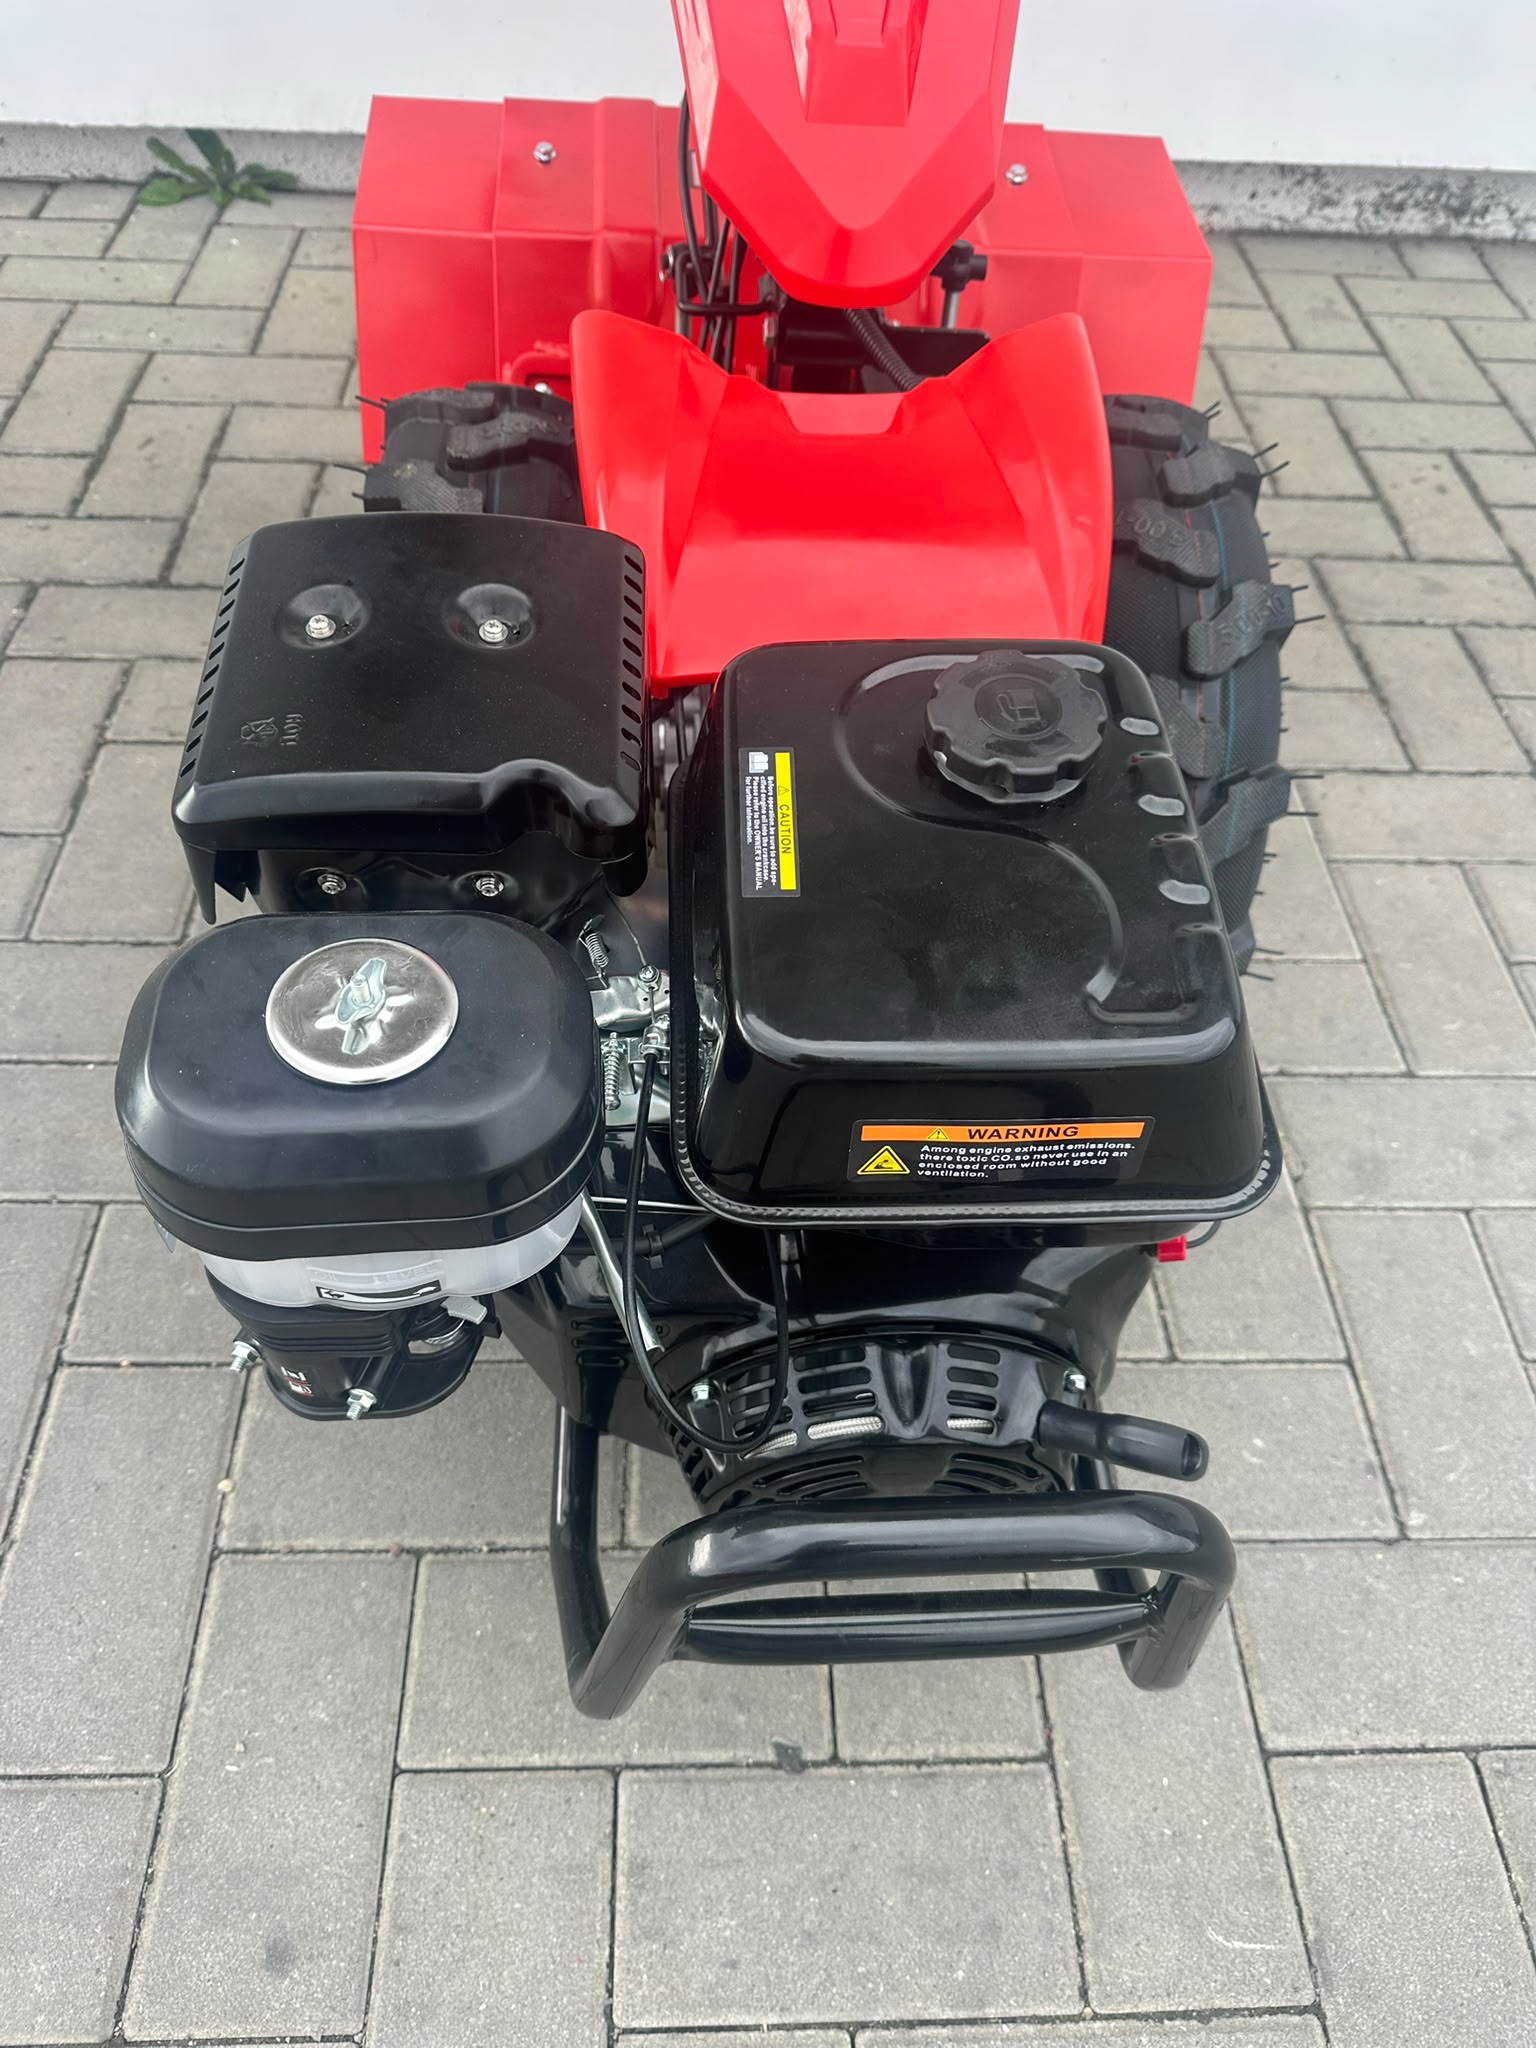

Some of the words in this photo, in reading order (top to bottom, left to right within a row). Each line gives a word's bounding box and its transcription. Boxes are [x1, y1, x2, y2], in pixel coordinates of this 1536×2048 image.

[779, 804, 792, 854] CAUTION
[968, 1126, 1078, 1140] WARNING
[921, 1145, 966, 1154] Among
[970, 1147, 1012, 1155] engine
[1015, 1144, 1064, 1153] exhaust
[1067, 1142, 1135, 1150] emissions.
[1033, 1152, 1069, 1160] never
[919, 1162, 980, 1170] enclosed
[1021, 1160, 1070, 1168] without
[1073, 1158, 1107, 1166] good
[917, 1170, 989, 1178] ventilation.
